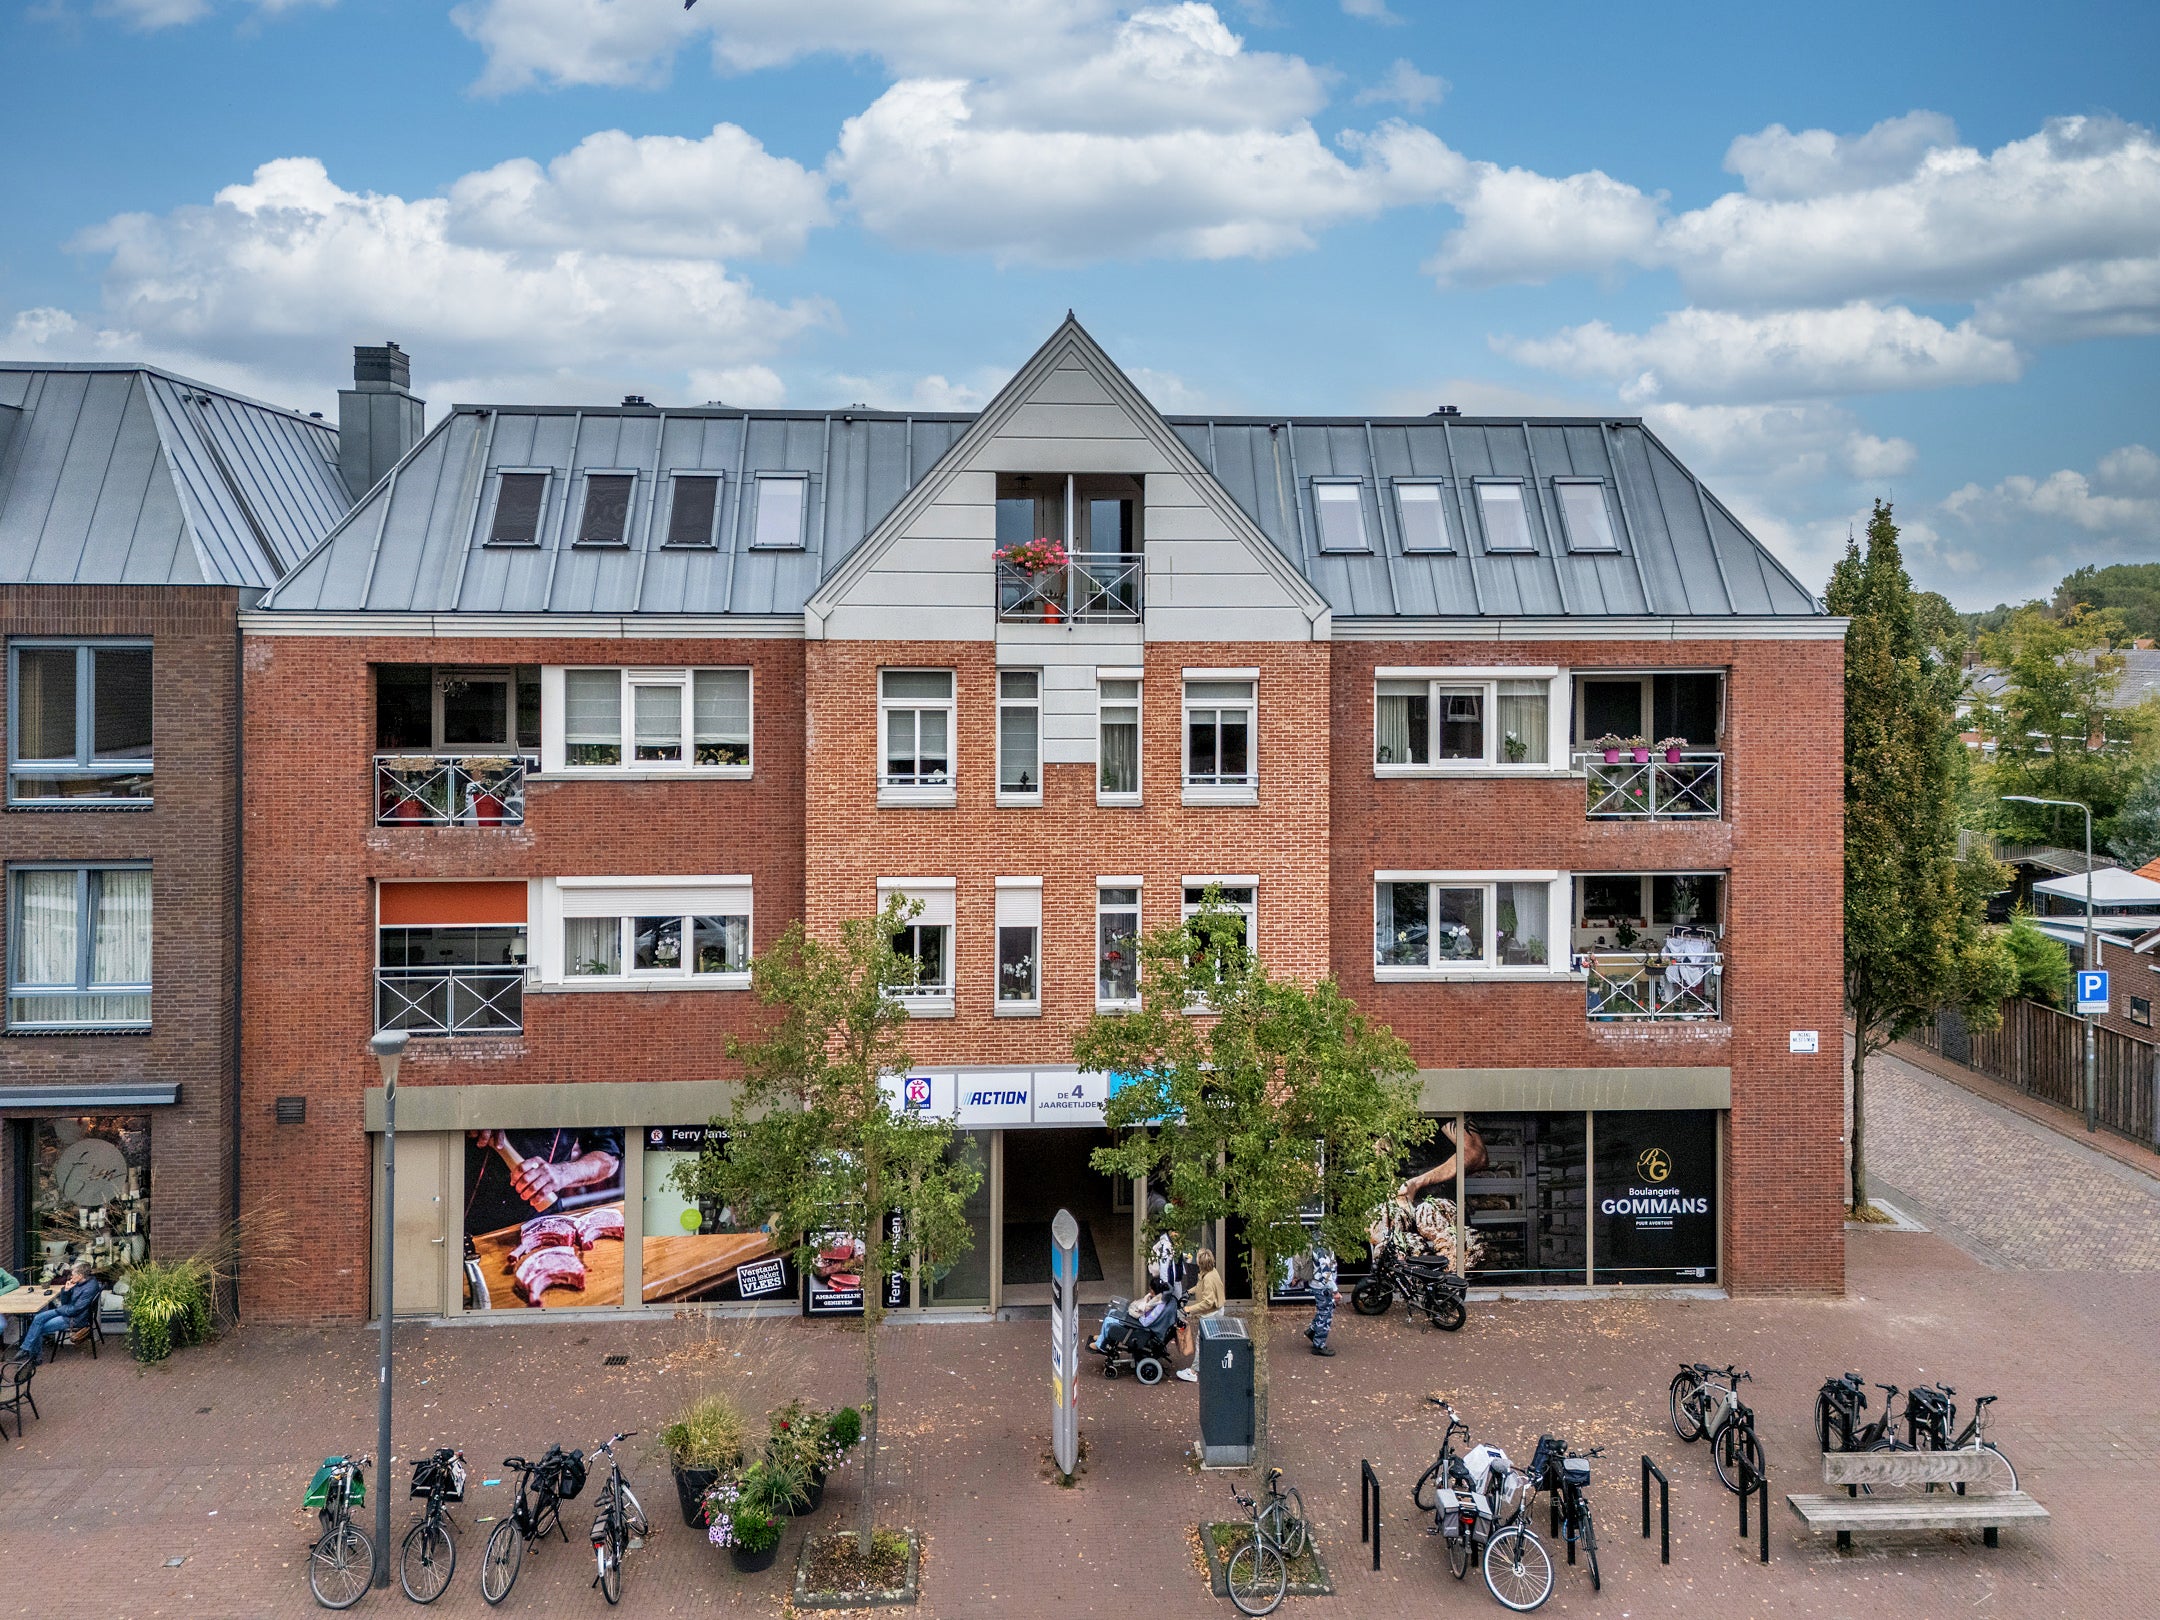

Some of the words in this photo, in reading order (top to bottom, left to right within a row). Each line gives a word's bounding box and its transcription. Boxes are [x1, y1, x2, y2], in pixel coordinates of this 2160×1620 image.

[2085, 975, 2102, 999] P
[909, 1085, 926, 1100] K
[970, 1090, 1028, 1106] ACTION
[1071, 1084, 1084, 1099] 4
[1038, 1101, 1104, 1109] JAARGETIJDEN
[672, 1129, 701, 1142] Ferry
[1628, 1187, 1680, 1197] Boulangerie
[1601, 1198, 1708, 1215] GOMMANS
[743, 1277, 782, 1292] VLEES
[889, 1271, 904, 1304] Ferry
